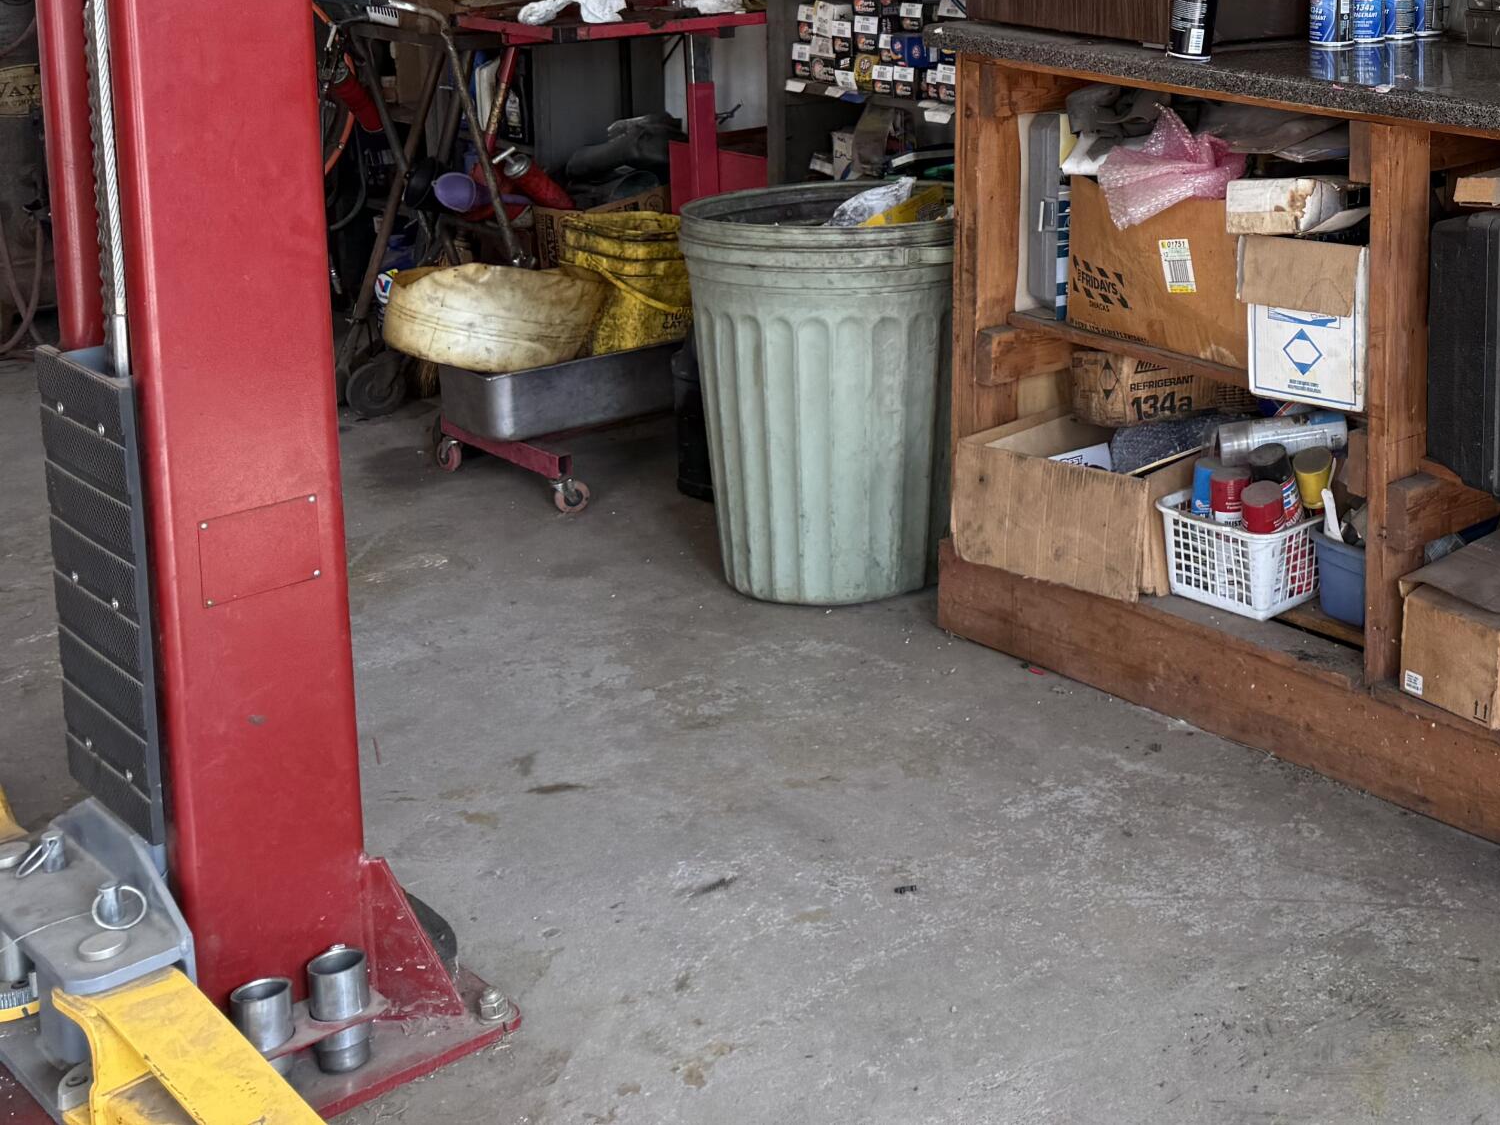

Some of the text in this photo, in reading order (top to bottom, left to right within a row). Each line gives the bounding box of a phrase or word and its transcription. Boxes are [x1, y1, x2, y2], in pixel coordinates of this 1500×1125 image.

[1354, 3, 1375, 12] -134a
[1166, 240, 1185, 249] 01751
[1081, 270, 1118, 296] FRIDAYS
[1130, 374, 1194, 392] REFRIGERANT
[1131, 390, 1193, 421] 134a
